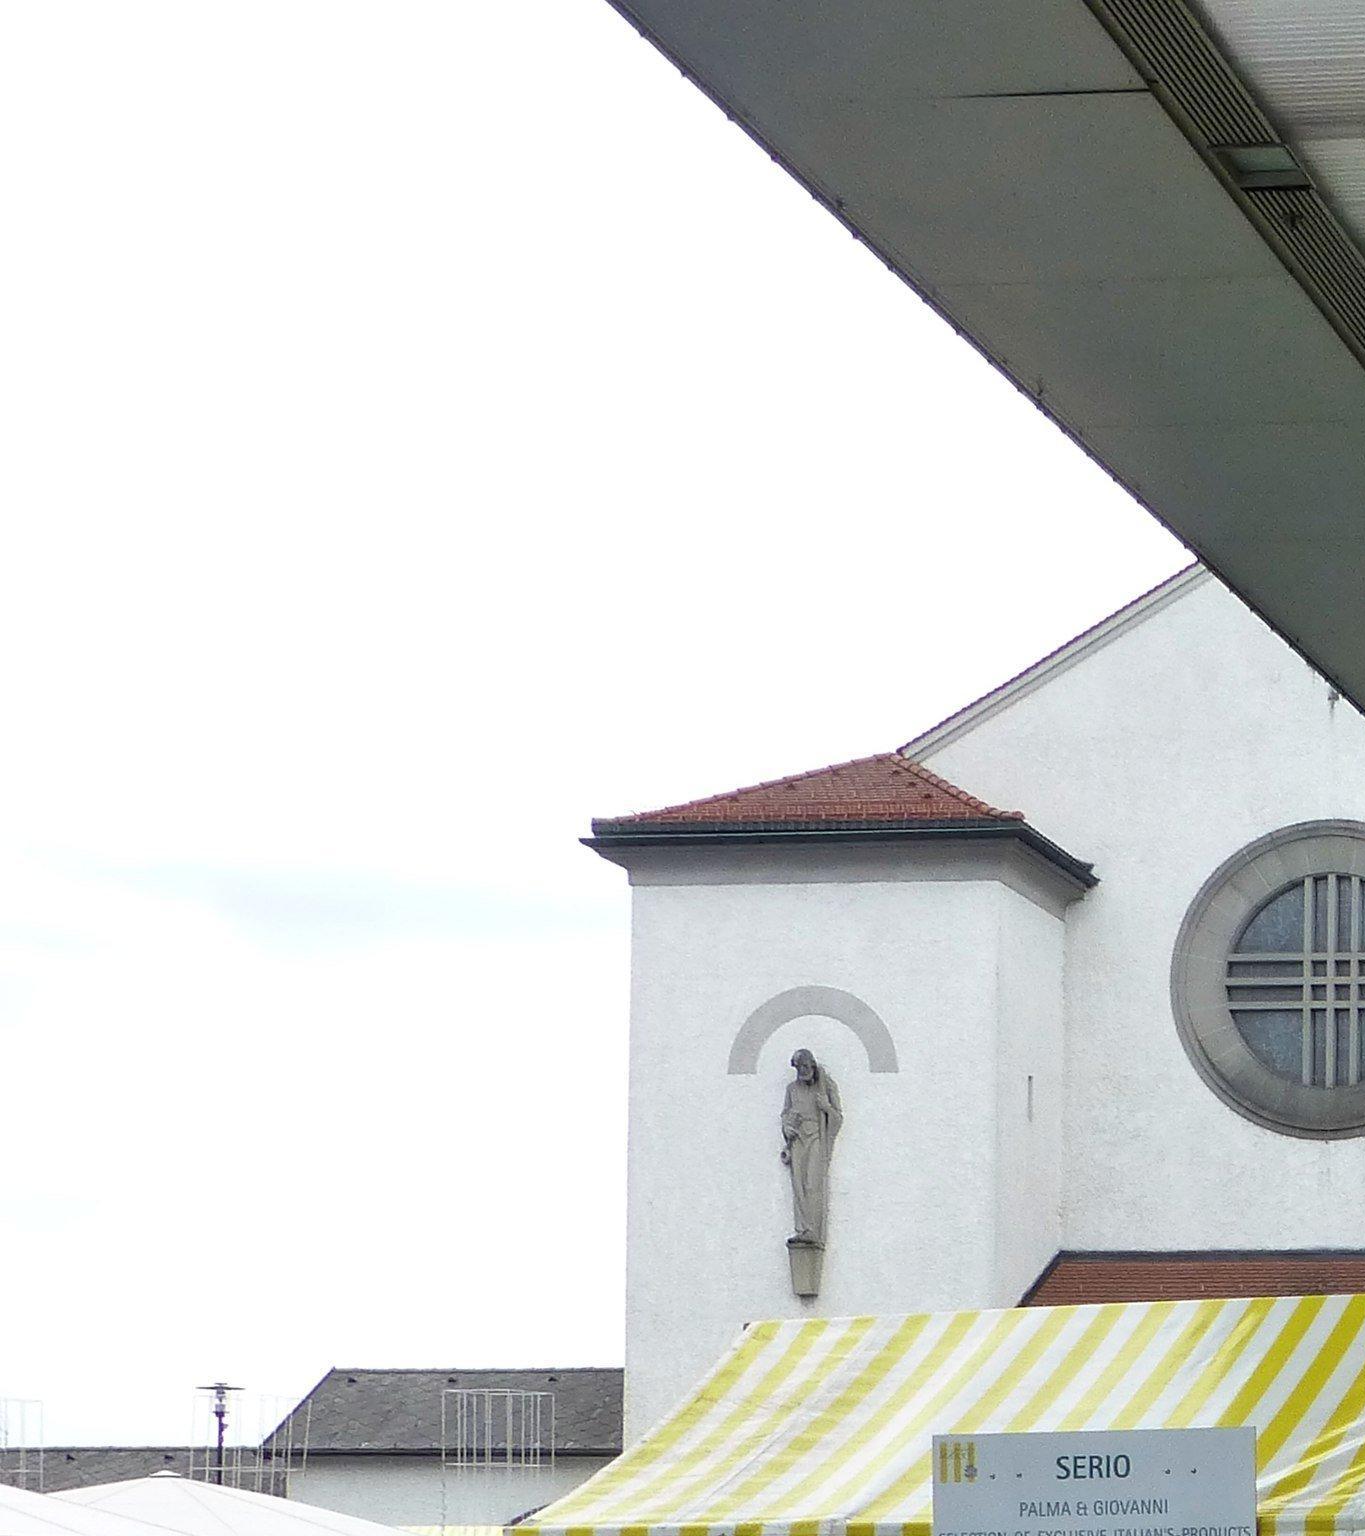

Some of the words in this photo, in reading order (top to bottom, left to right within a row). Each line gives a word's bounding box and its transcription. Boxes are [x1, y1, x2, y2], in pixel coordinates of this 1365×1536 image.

[1055, 1453, 1132, 1480] SERIO
[1018, 1501, 1072, 1518] PALMA
[1075, 1502, 1089, 1517] &
[1093, 1498, 1169, 1515] GIOVANNI
